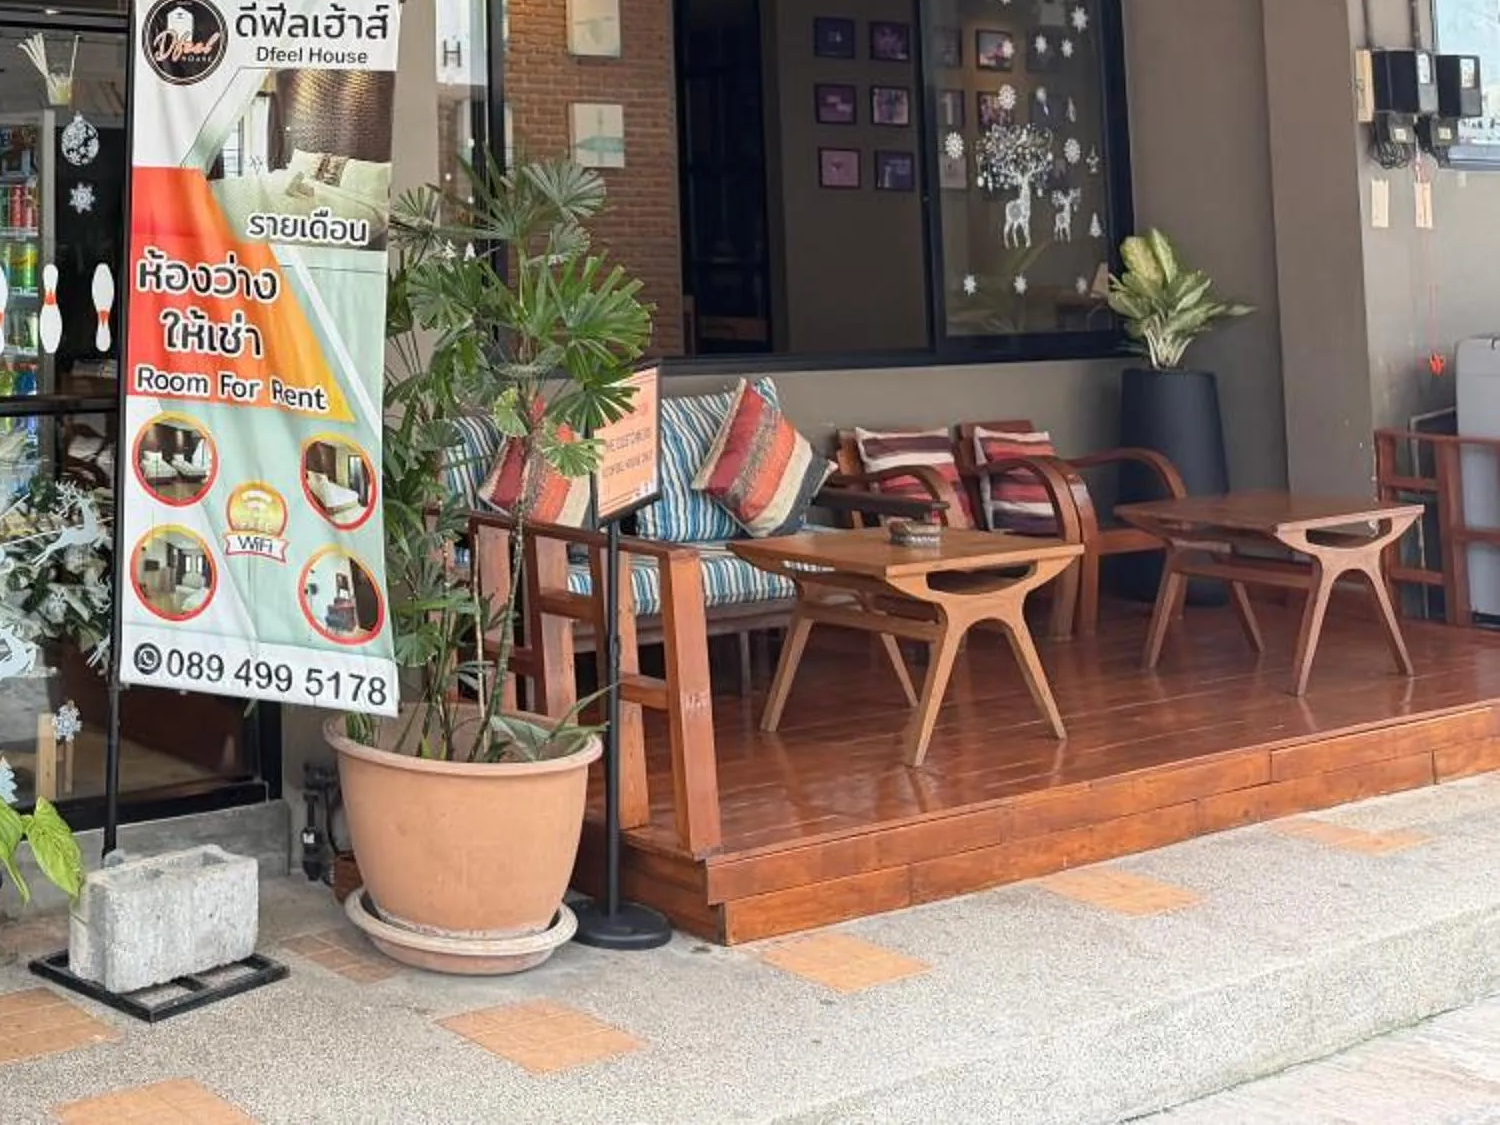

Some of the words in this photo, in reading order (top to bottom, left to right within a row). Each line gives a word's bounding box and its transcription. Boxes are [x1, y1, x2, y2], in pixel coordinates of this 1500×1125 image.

[235, 2, 390, 41] ดีฟีลเฮ้าส์
[255, 45, 304, 63] Dfeel
[308, 46, 369, 65] House
[247, 208, 369, 244] รายเดือน
[136, 248, 281, 301] ห้องว่าง
[159, 307, 263, 357] ให้เช่า
[136, 366, 209, 395] Room
[219, 374, 261, 400] For
[271, 377, 329, 411] Rent
[166, 648, 225, 684] 089
[233, 658, 293, 693] 499
[304, 668, 388, 707] 5178
